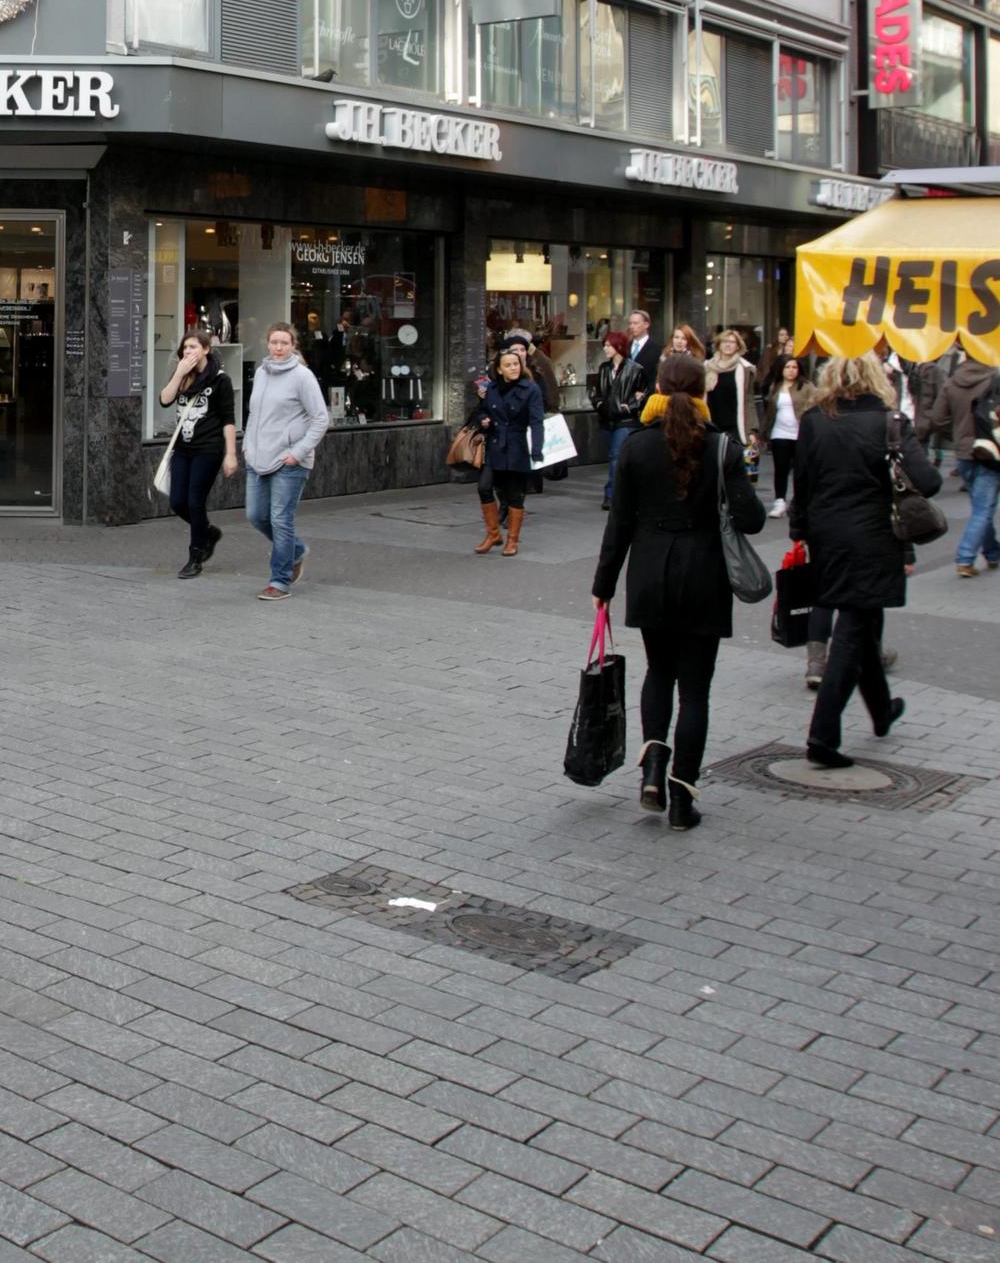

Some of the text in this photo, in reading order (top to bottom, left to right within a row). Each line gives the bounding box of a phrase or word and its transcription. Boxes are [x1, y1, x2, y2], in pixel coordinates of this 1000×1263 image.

[325, 99, 502, 162] J.H. BECKER
[662, 153, 739, 195] BECKER
[296, 249, 365, 266] GEORG JENSEN
